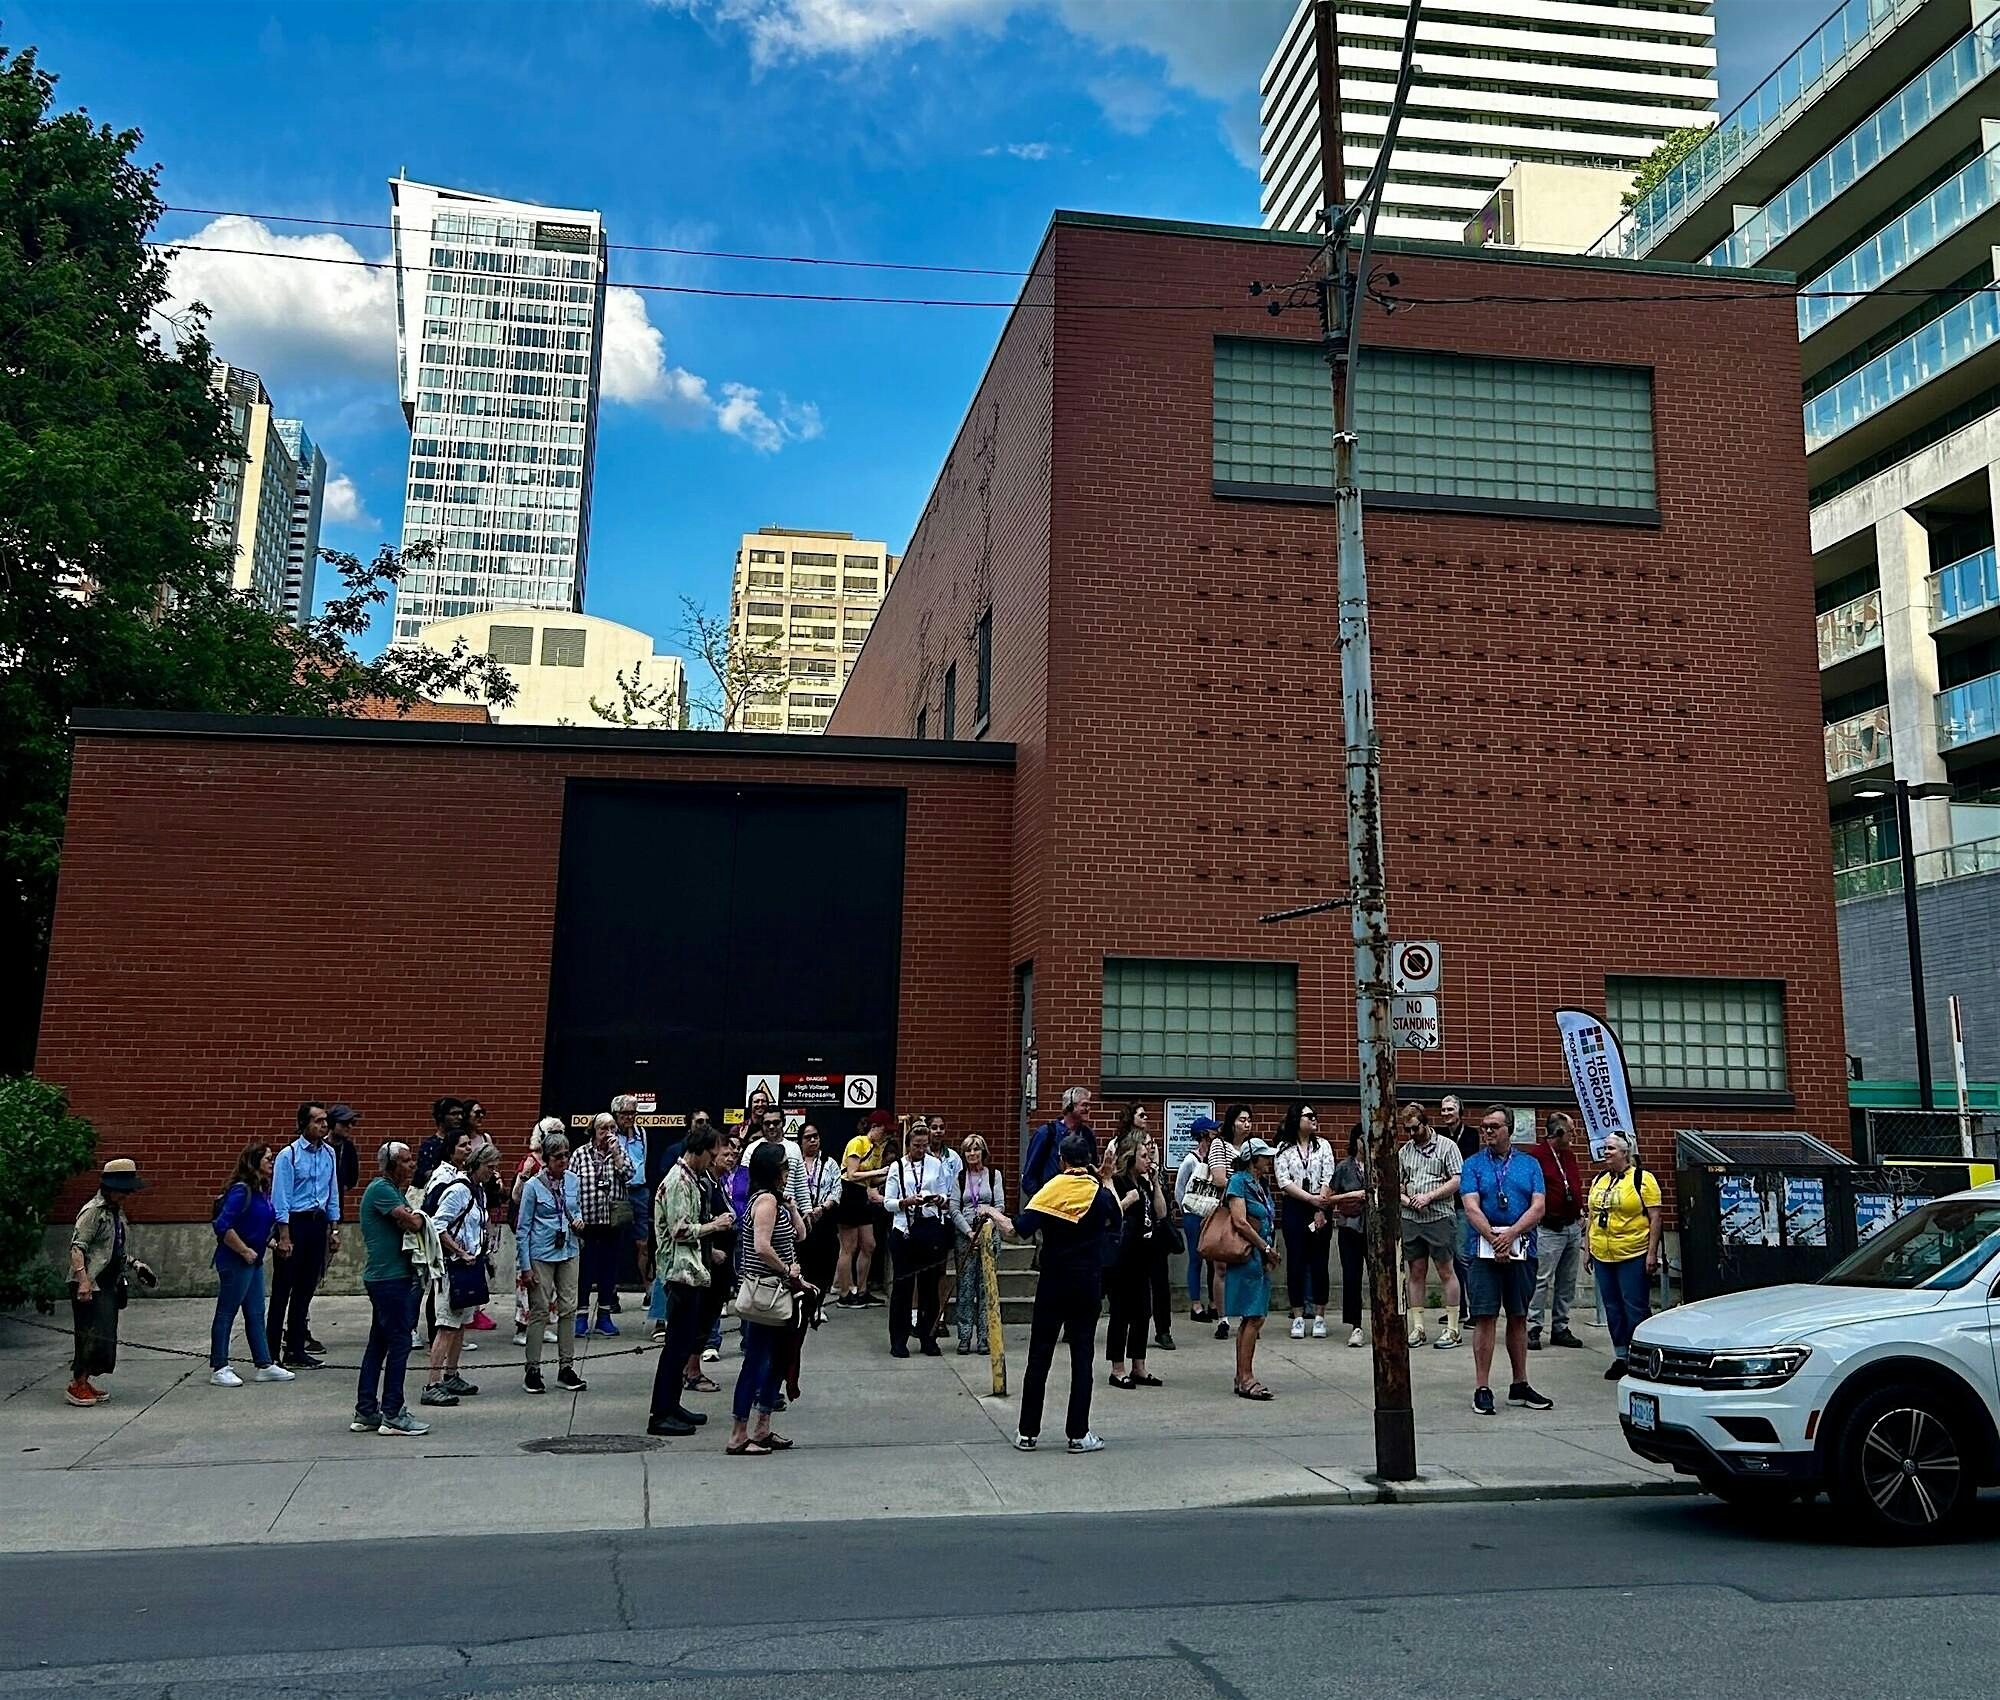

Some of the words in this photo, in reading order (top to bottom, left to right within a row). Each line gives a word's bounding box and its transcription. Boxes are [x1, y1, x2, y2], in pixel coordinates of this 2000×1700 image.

[1406, 1000, 1422, 1014] NO
[1393, 1017, 1436, 1030] STANDING
[1585, 1057, 1611, 1128] TORONTO
[1596, 1055, 1620, 1127] HERITAGE
[573, 1116, 589, 1125] DO
[652, 1116, 683, 1125] DRIVE
